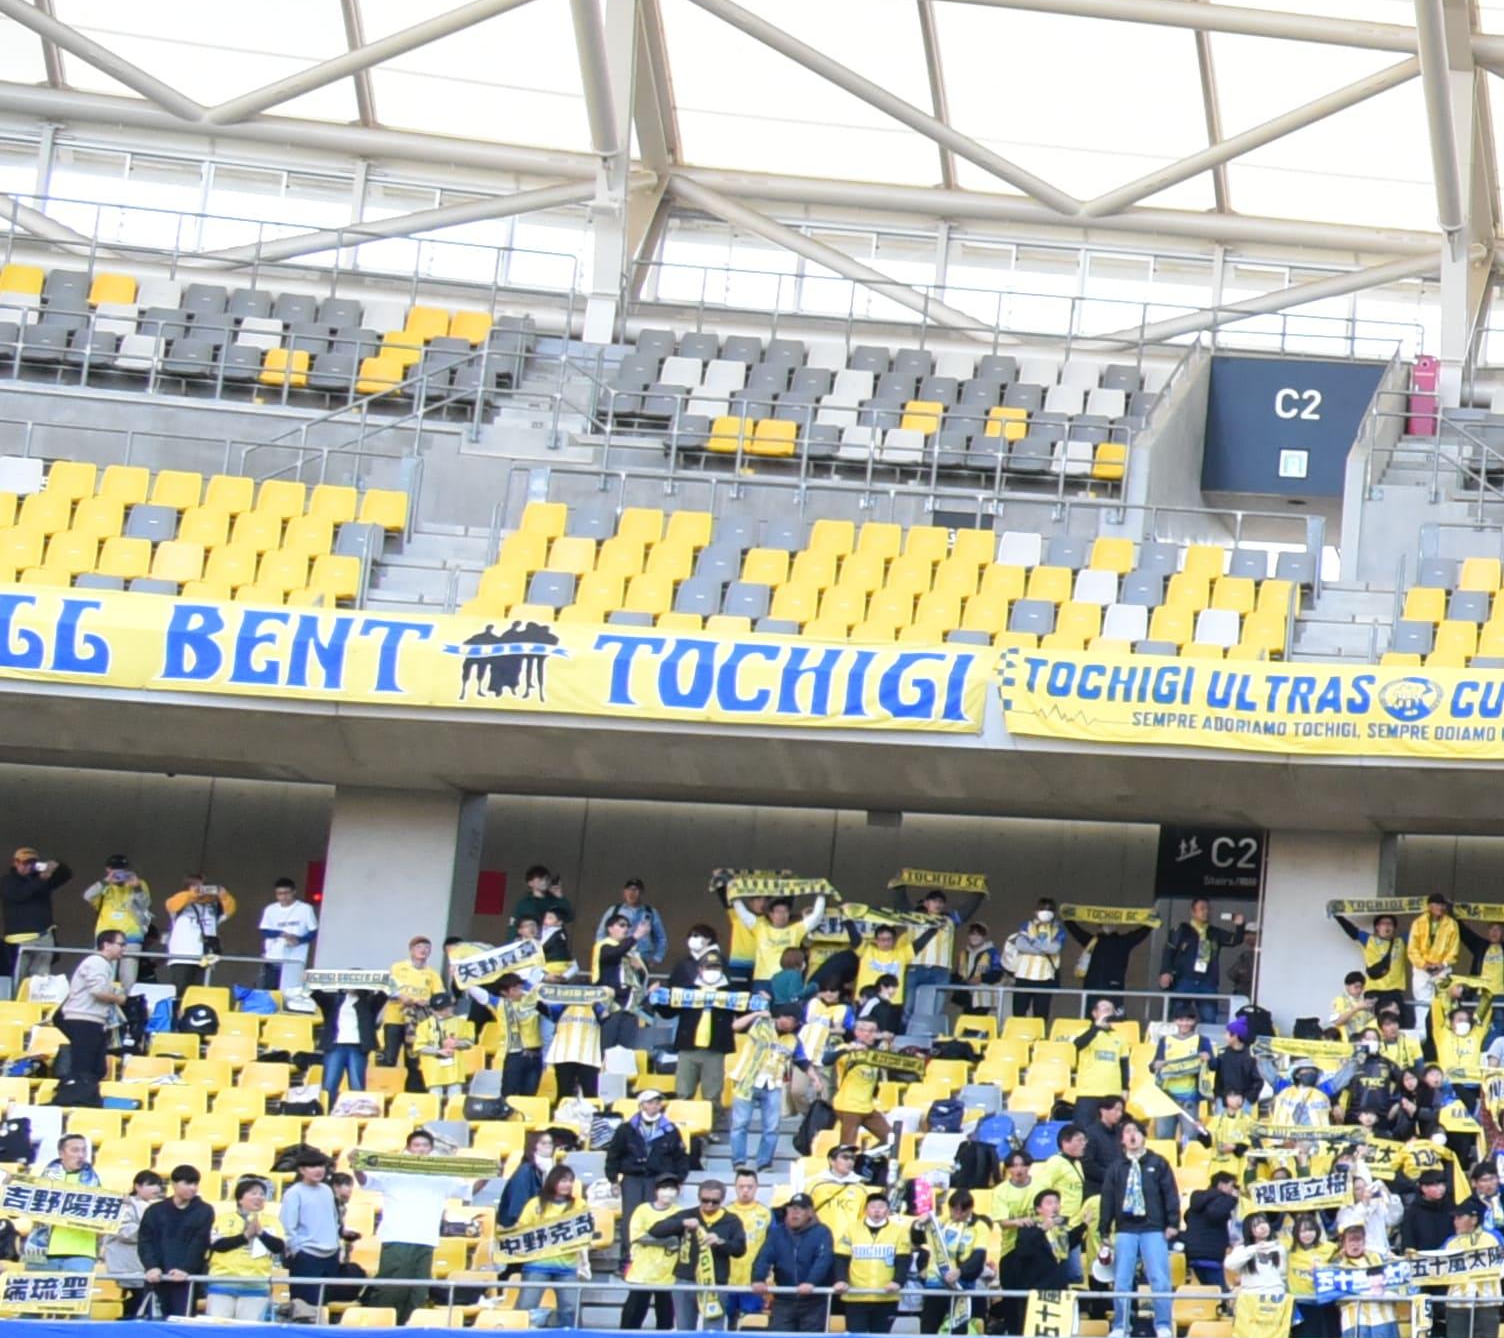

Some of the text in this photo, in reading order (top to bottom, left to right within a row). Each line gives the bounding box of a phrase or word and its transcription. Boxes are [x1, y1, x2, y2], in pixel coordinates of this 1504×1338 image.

[1275, 388, 1322, 420] C2
[160, 602, 434, 693] BENT
[595, 633, 976, 723] TOCHIGI
[1024, 657, 1194, 706] TOCHIGI
[1207, 670, 1377, 716] ULTRAS
[1132, 711, 1198, 729] SEMPRE
[1202, 716, 1288, 736] ADORIAMO
[1367, 723, 1431, 741] SEMPRE
[1211, 836, 1258, 869] C2
[2, 1185, 123, 1221] 吉野陽翔
